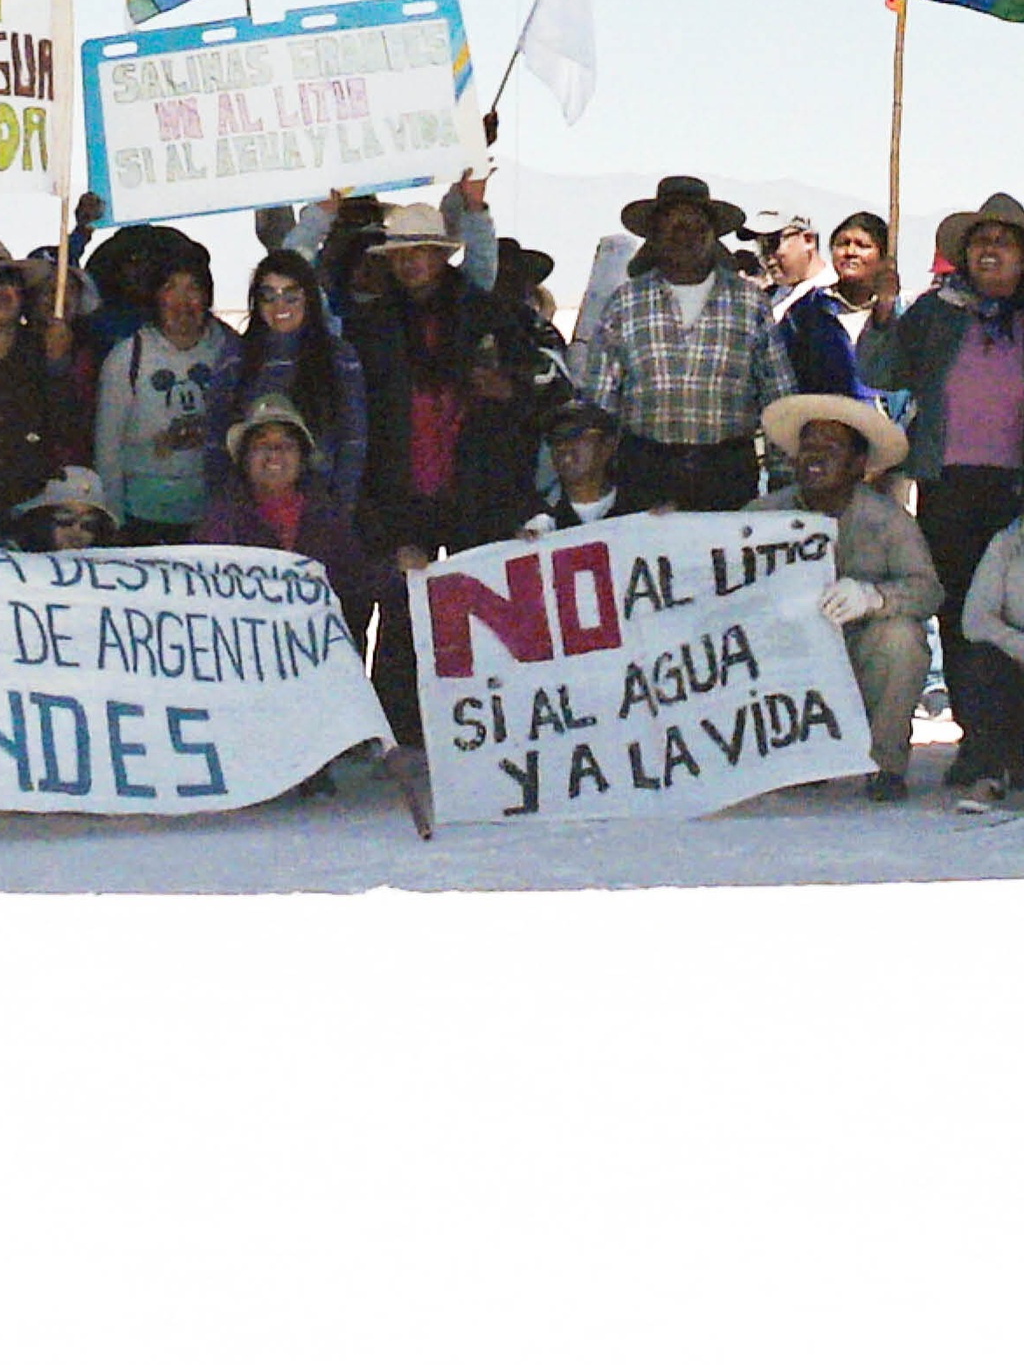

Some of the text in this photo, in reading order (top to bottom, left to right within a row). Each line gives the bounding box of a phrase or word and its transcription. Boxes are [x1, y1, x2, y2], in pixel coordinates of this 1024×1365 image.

[112, 44, 273, 104] SALINAS
[218, 91, 263, 137] AL
[114, 146, 156, 189] SI
[166, 140, 207, 183] AL
[9, 601, 79, 667] DE
[97, 606, 359, 682] ARGENTINA
[427, 541, 622, 678] NO
[624, 555, 694, 620] AL
[529, 685, 598, 741] AL
[618, 624, 760, 719] AGUA
[498, 750, 540, 816] Y
[568, 744, 610, 799] A
[628, 725, 700, 789] LA
